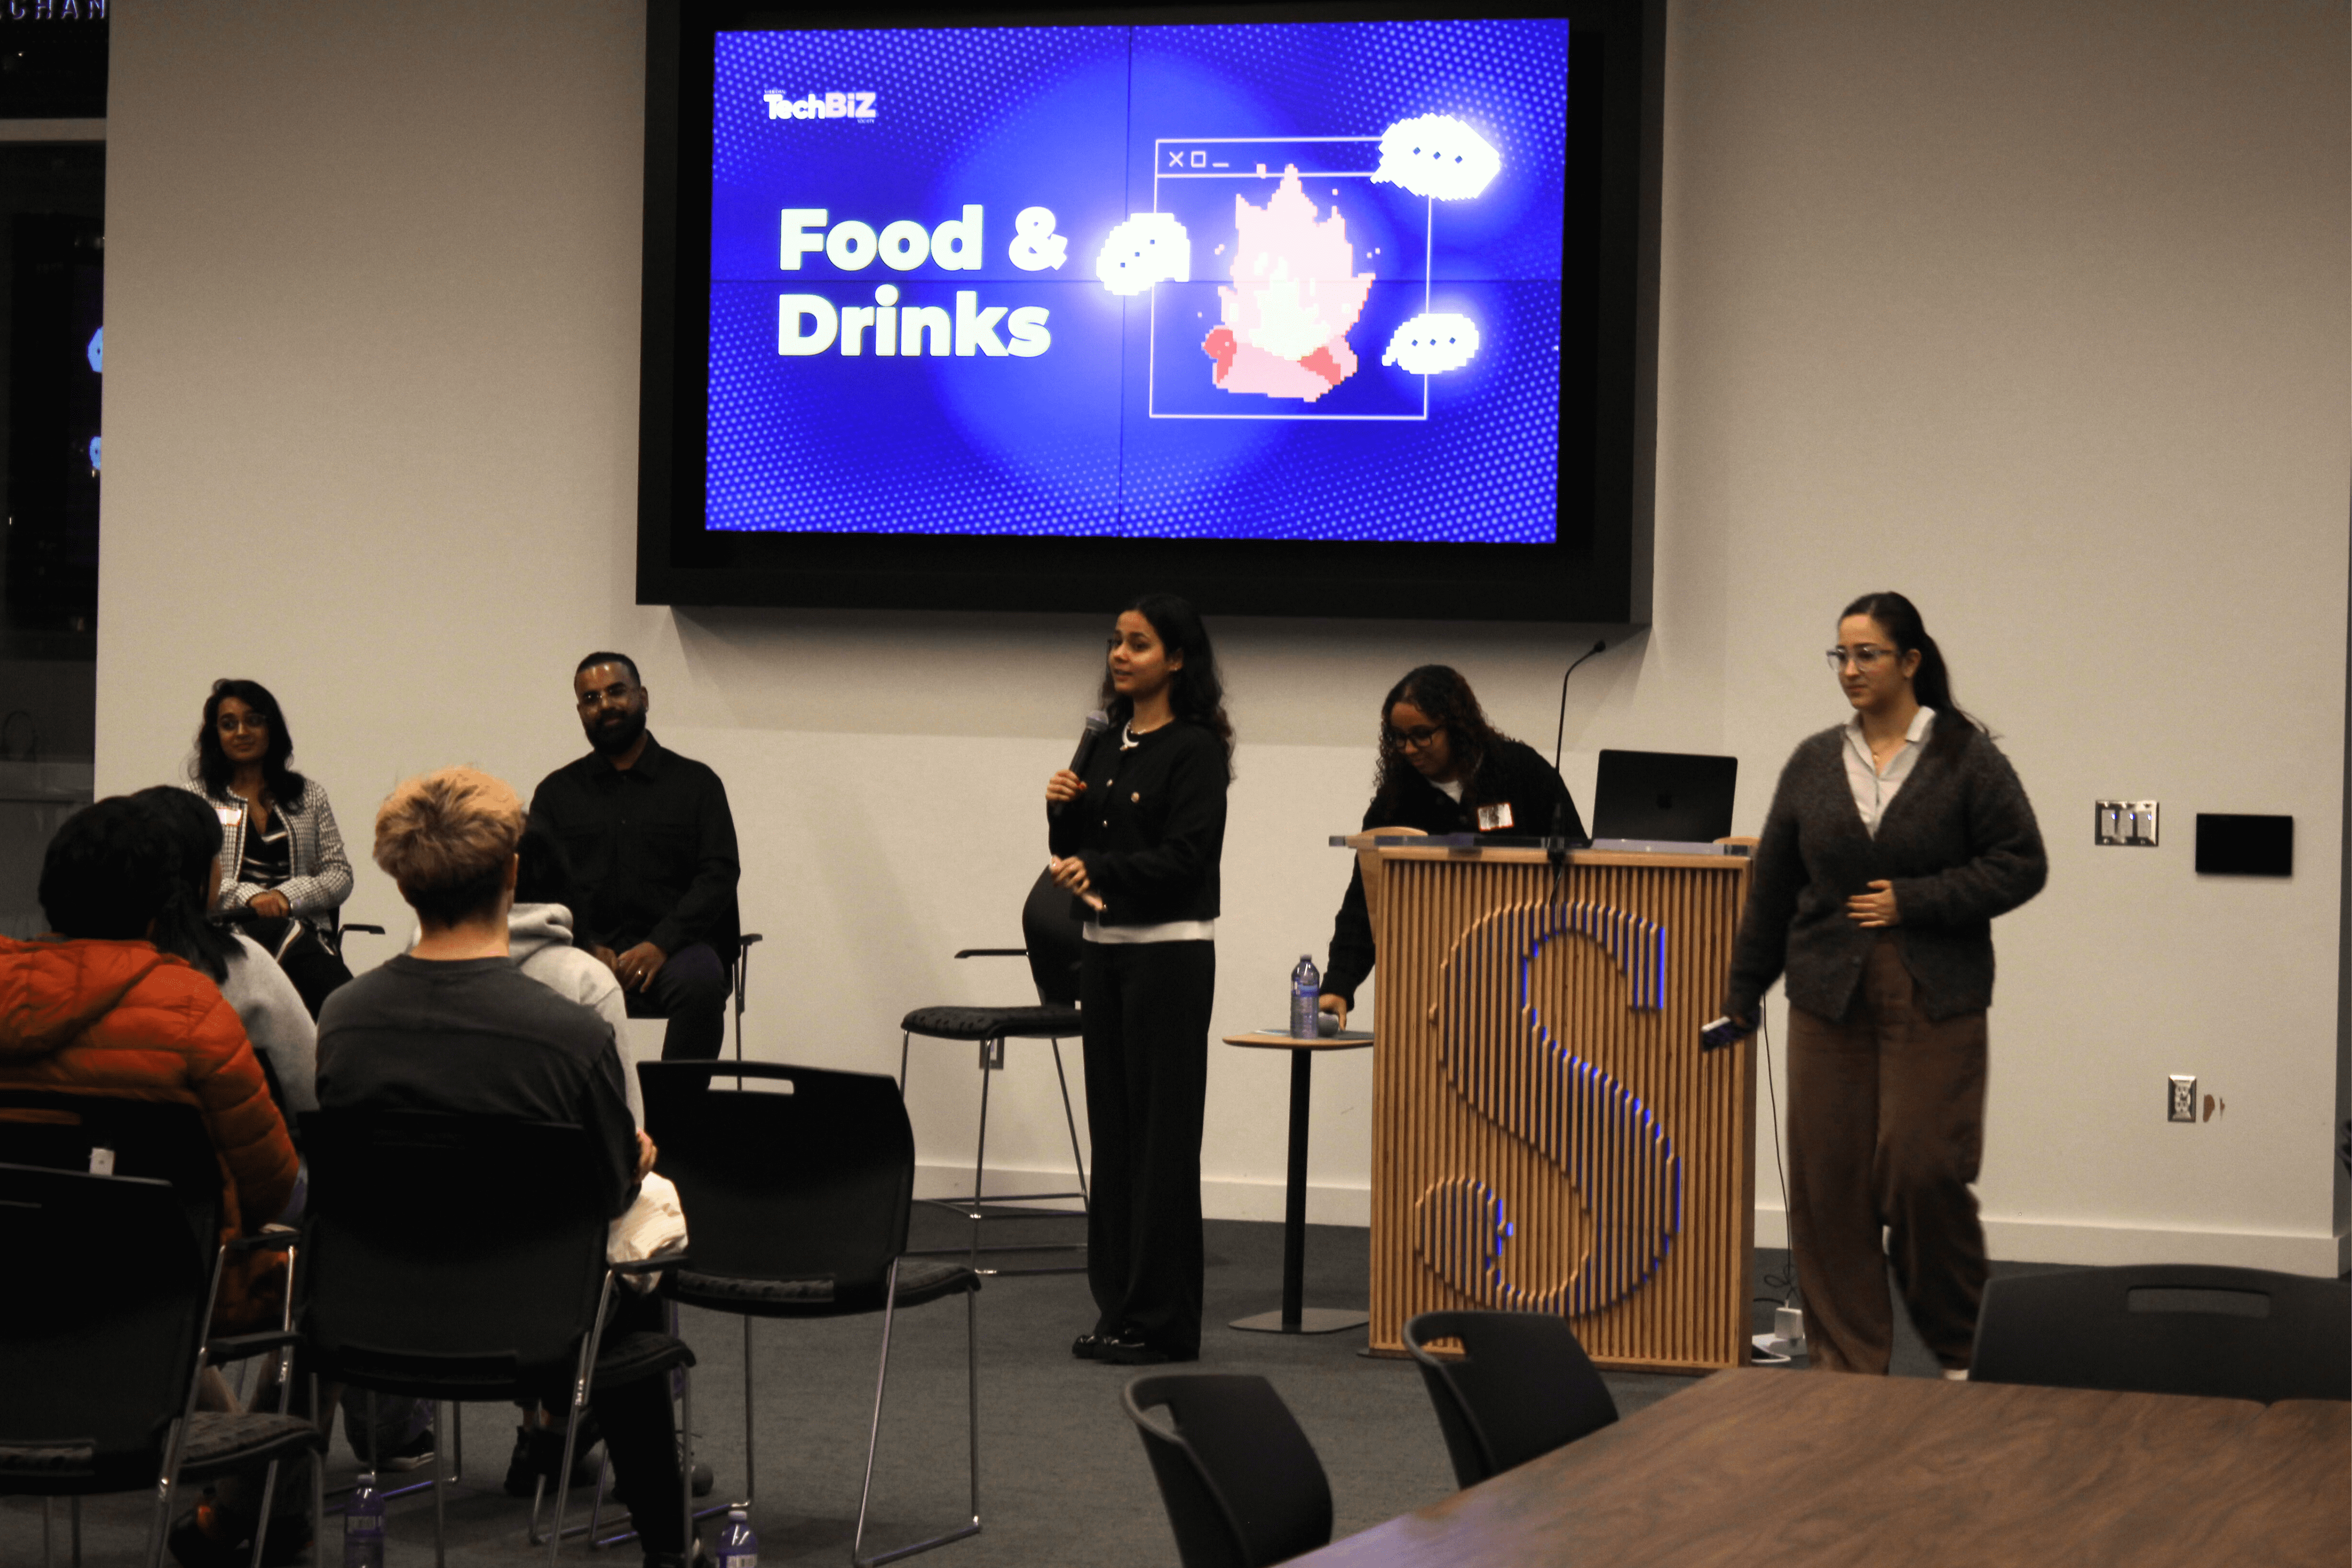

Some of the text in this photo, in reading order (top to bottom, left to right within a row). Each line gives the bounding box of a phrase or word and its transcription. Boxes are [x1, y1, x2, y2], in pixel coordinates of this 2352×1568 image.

[0, 0, 106, 19] CHAN
[780, 204, 1068, 271] Food &
[778, 284, 1051, 358] Drinks
[1414, 900, 1681, 1319] S
